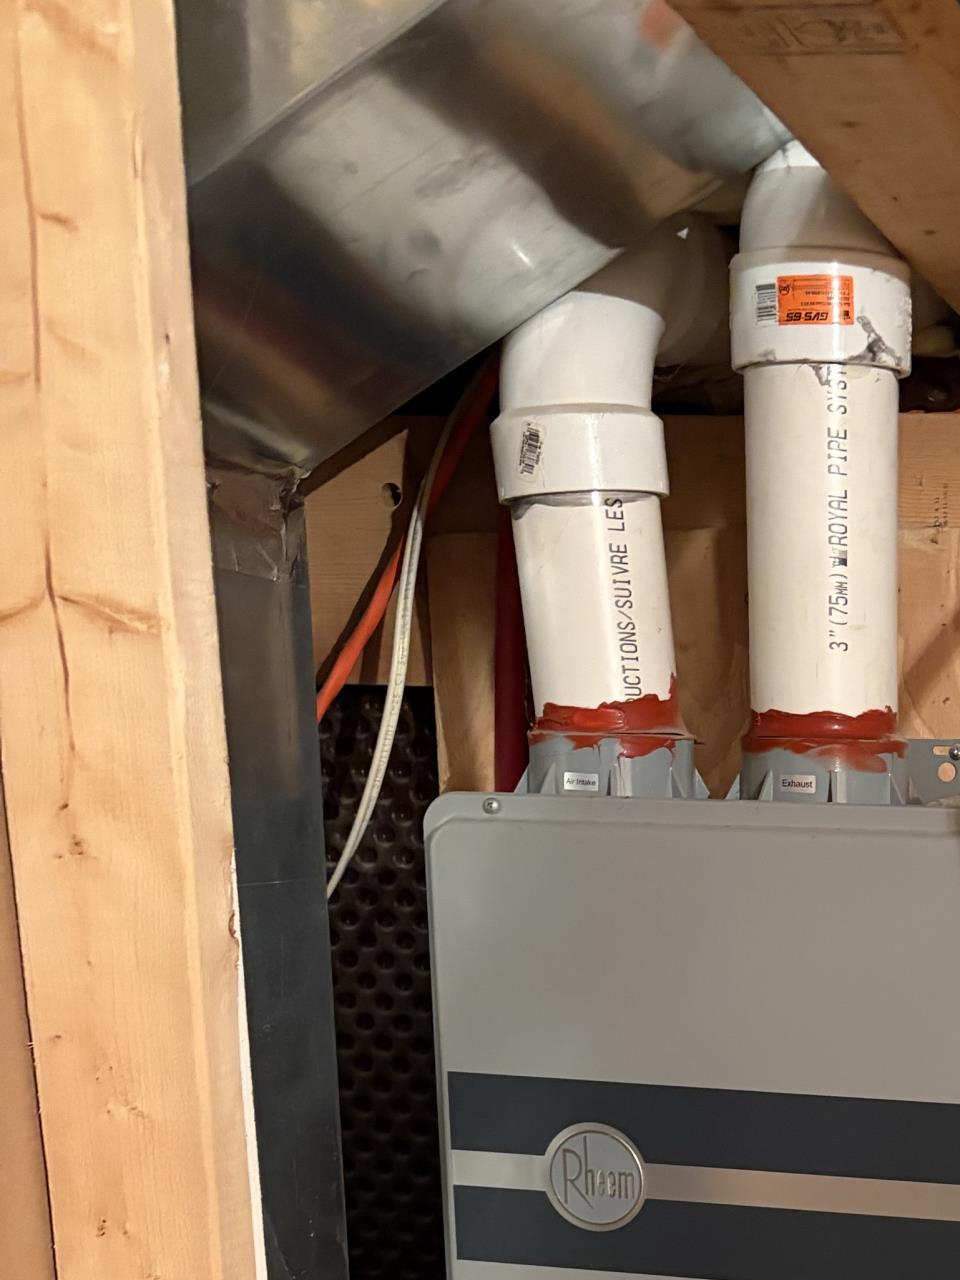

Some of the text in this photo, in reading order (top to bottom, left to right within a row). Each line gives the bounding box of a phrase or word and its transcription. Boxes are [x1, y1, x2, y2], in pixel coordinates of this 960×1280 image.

[827, 427, 847, 476] PIPE
[604, 497, 626, 532] LES
[827, 489, 847, 547] ROYAL
[781, 779, 814, 788] Exhaust
[556, 1136, 637, 1207] Rheem
